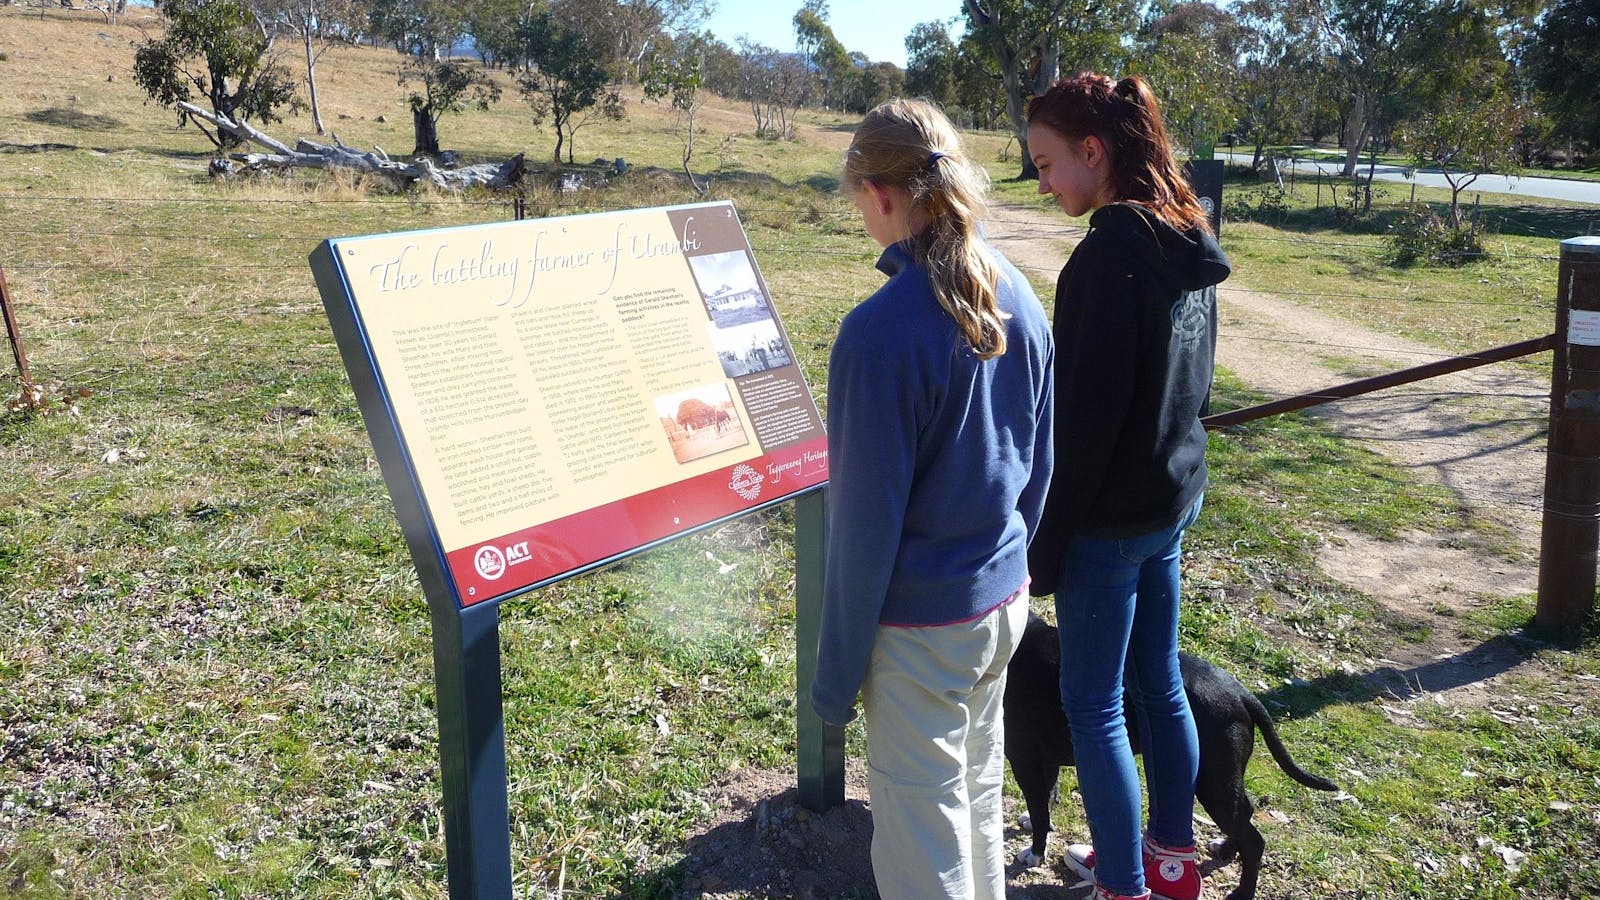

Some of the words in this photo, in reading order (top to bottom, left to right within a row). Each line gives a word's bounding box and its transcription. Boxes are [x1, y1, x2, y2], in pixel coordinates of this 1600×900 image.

[369, 244, 422, 292] The
[432, 239, 519, 307] battling
[512, 230, 594, 308] farmer
[596, 222, 628, 296] of
[628, 216, 702, 259] Urambi
[505, 541, 530, 561] ACT
